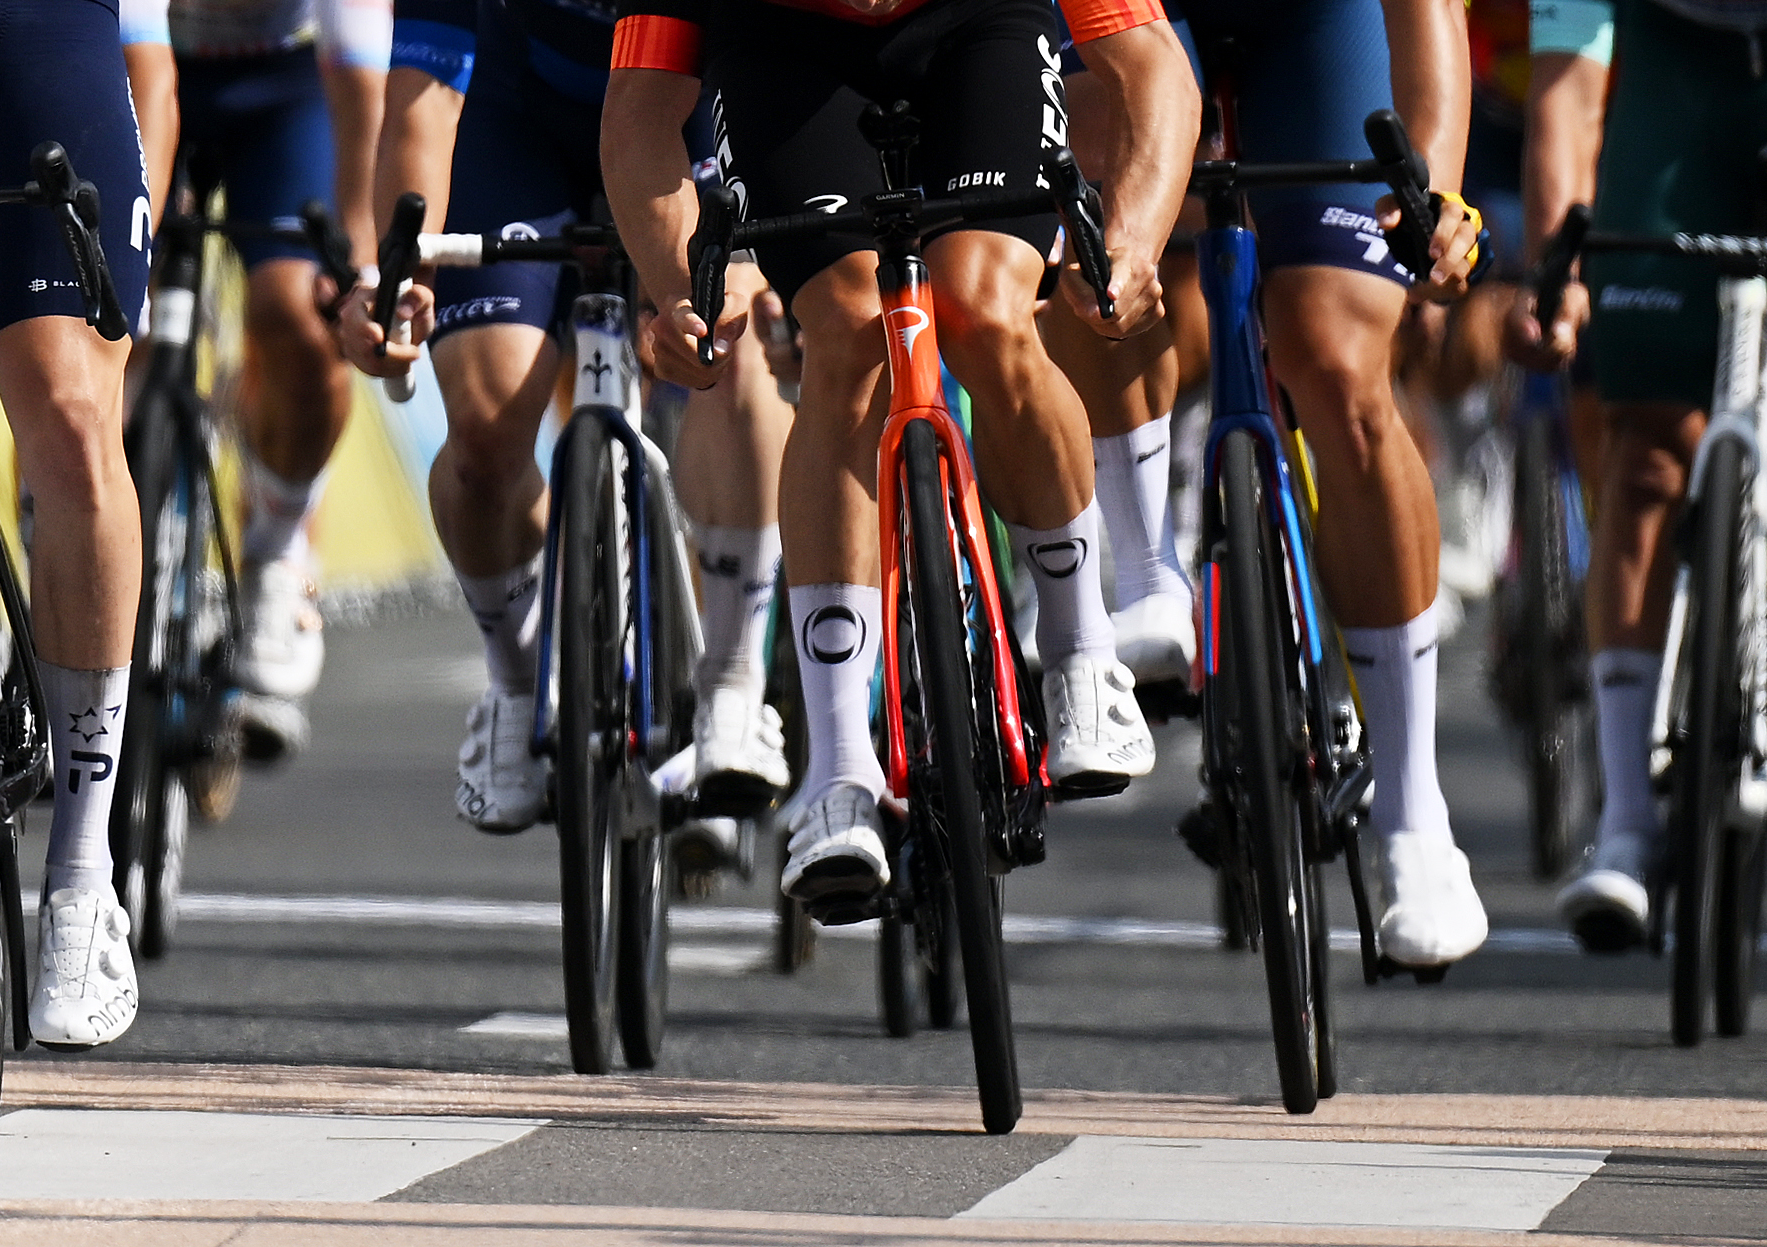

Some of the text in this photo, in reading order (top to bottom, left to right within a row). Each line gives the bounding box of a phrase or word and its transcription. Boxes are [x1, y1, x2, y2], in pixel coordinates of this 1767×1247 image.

[946, 171, 1007, 193] GOBIK
[875, 192, 906, 201] GARMIN
[87, 976, 139, 1038] nimbl
